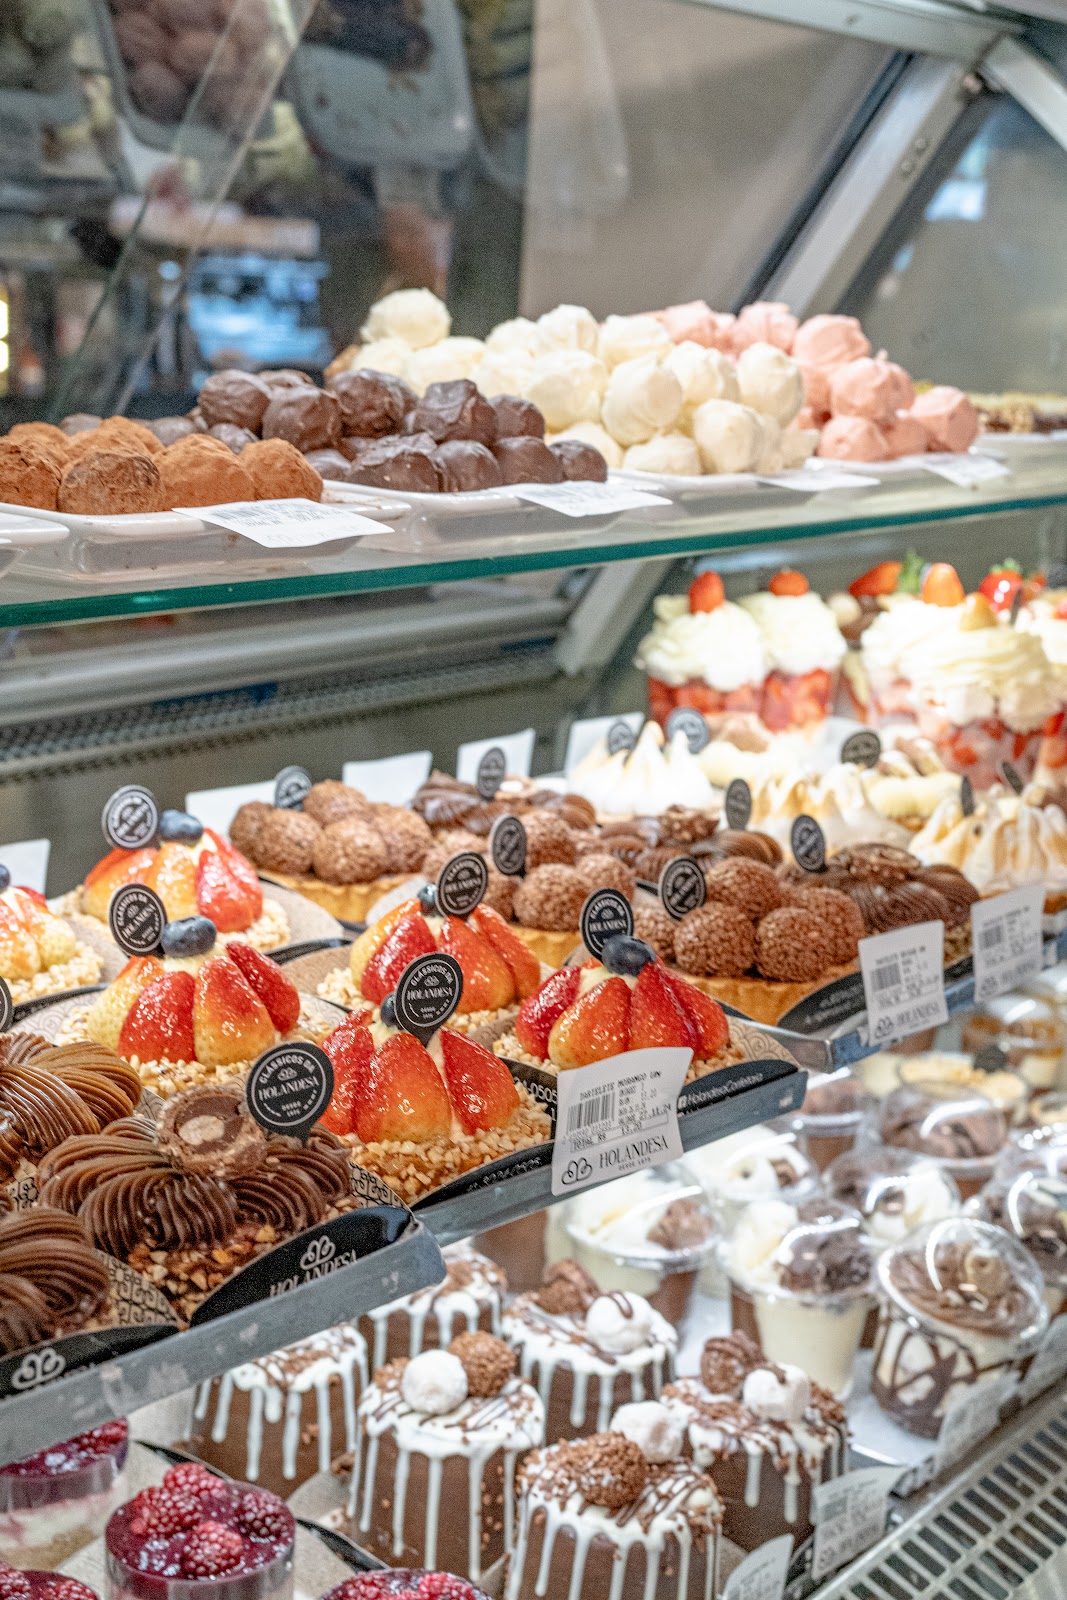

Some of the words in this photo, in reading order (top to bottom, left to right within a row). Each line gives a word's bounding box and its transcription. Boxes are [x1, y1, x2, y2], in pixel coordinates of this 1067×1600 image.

[407, 986, 454, 1001] HOLANDESA
[258, 1076, 320, 1101] HOLANDESA
[599, 1134, 669, 1168] HOLANDESA
